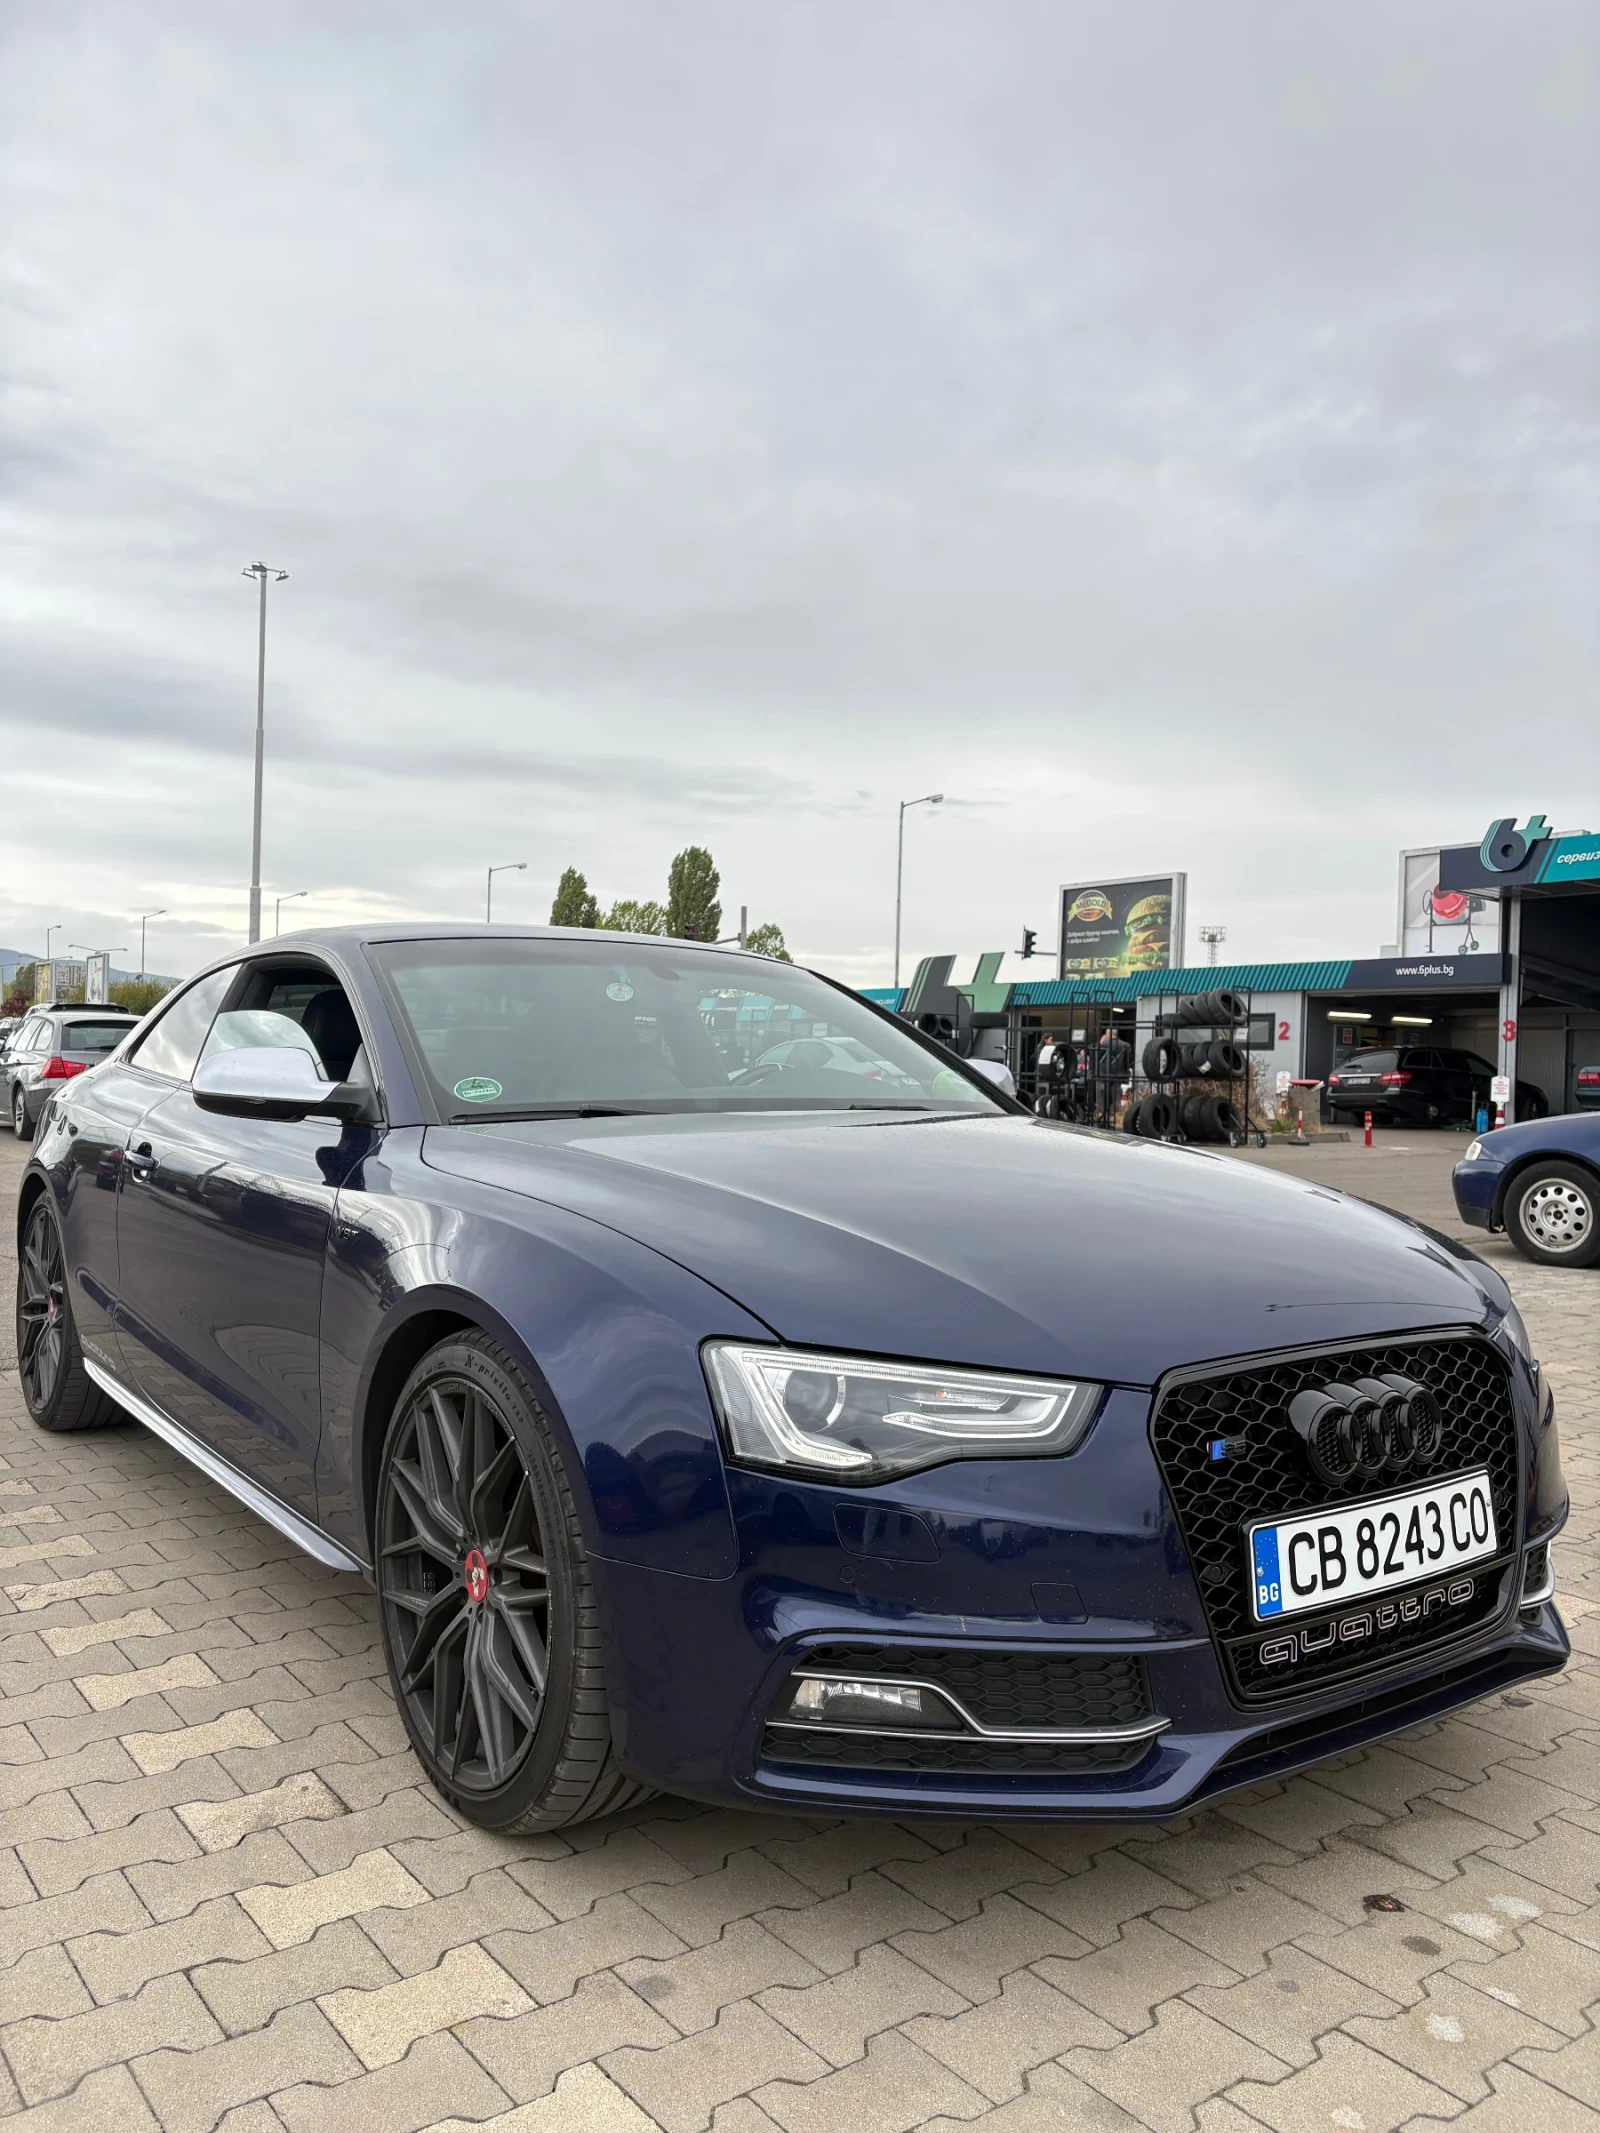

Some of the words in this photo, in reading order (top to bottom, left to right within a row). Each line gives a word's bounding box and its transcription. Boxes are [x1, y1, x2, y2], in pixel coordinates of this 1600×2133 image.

[1395, 964, 1455, 977] www.6plus.bg
[1278, 1020, 1290, 1041] 2
[1502, 1019, 1516, 1042] 3
[1287, 1524, 1347, 1597] CB
[1356, 1500, 1446, 1580] 8243
[1449, 1487, 1490, 1551] CO
[1258, 1581, 1280, 1605] BG
[1259, 1577, 1475, 1665] quattro
